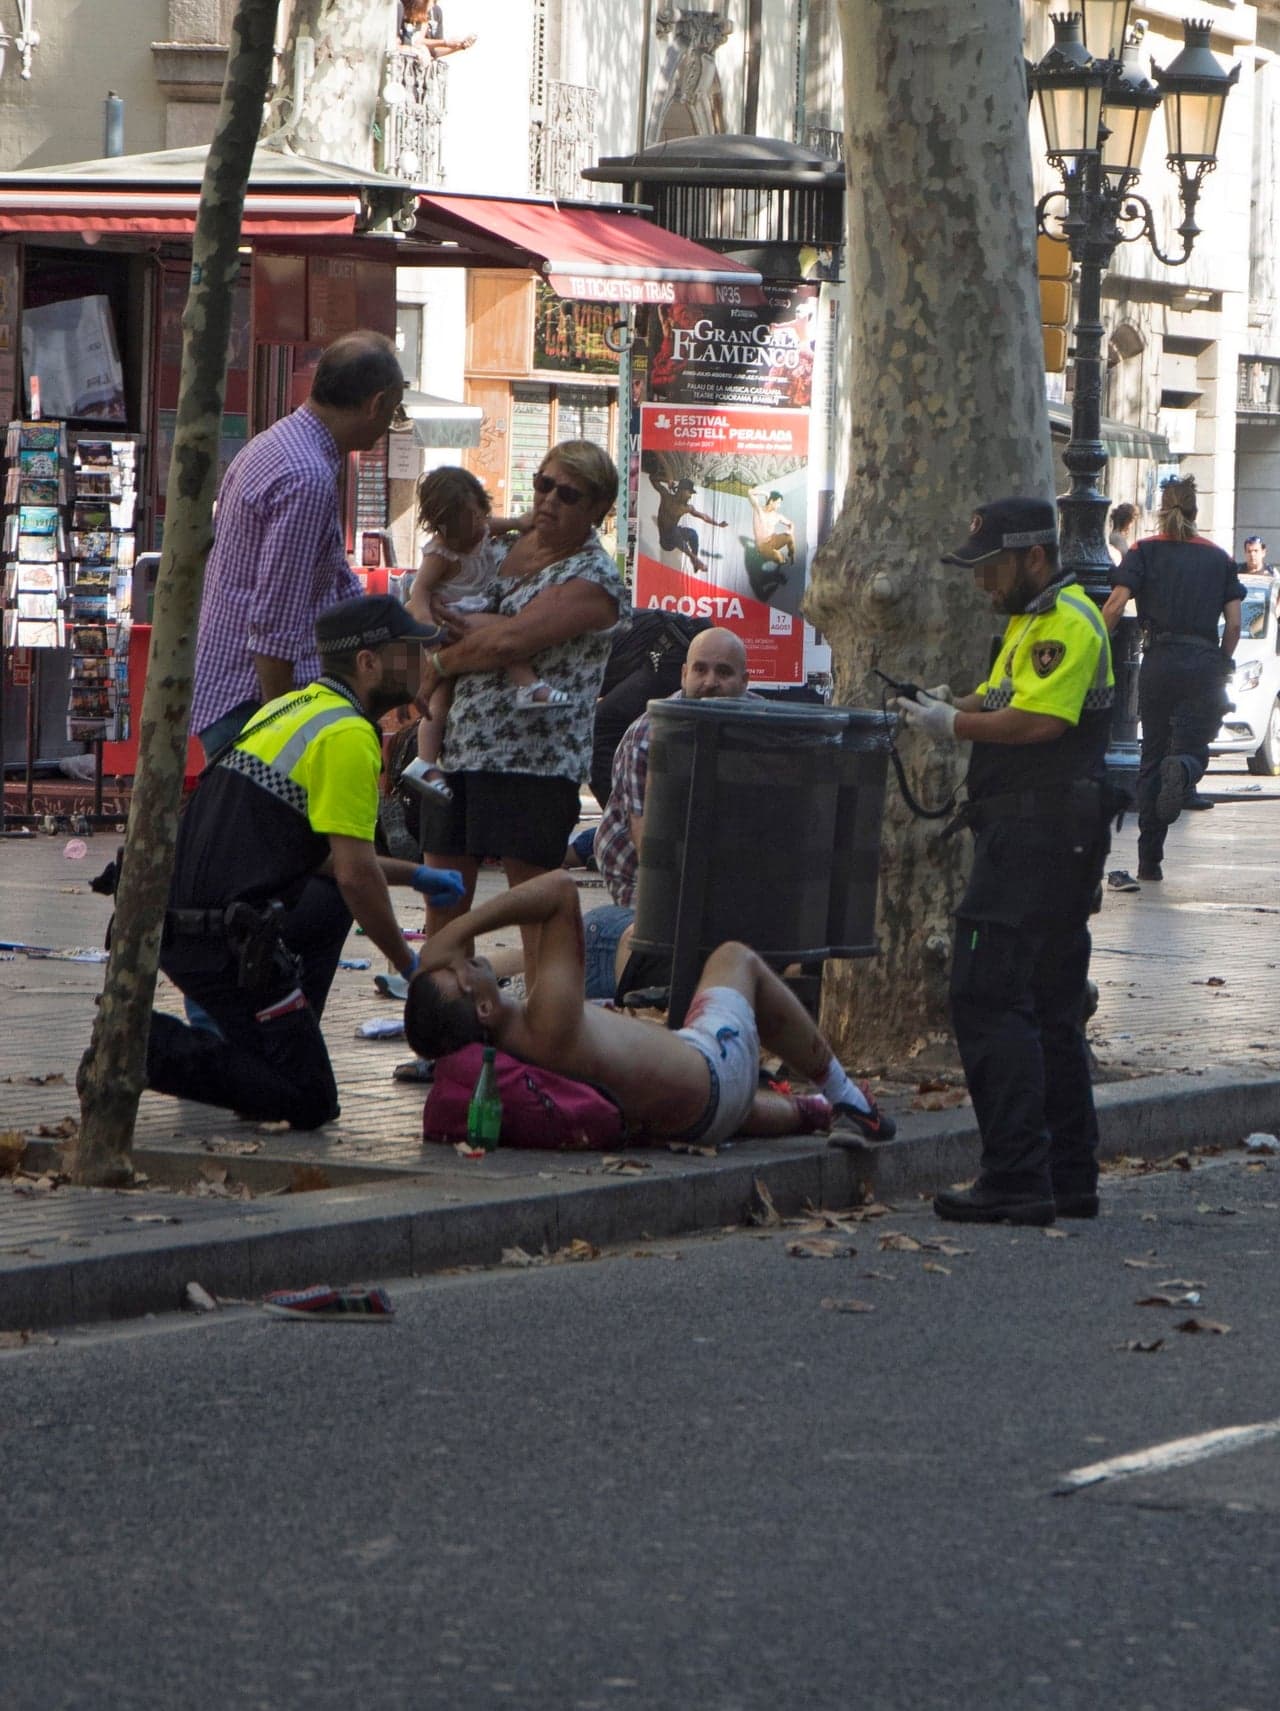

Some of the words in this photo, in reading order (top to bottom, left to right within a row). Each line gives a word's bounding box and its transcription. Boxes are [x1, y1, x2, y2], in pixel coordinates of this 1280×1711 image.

[585, 278, 631, 299] TICKETS
[643, 281, 675, 303] TRIAS
[670, 328, 799, 369] FLAMENCO
[674, 415, 729, 427] FESTIVAL
[674, 427, 726, 439] CASTELL
[729, 429, 792, 441] PERALADA
[648, 595, 744, 618] ACOSTA
[776, 615, 786, 624] 17
